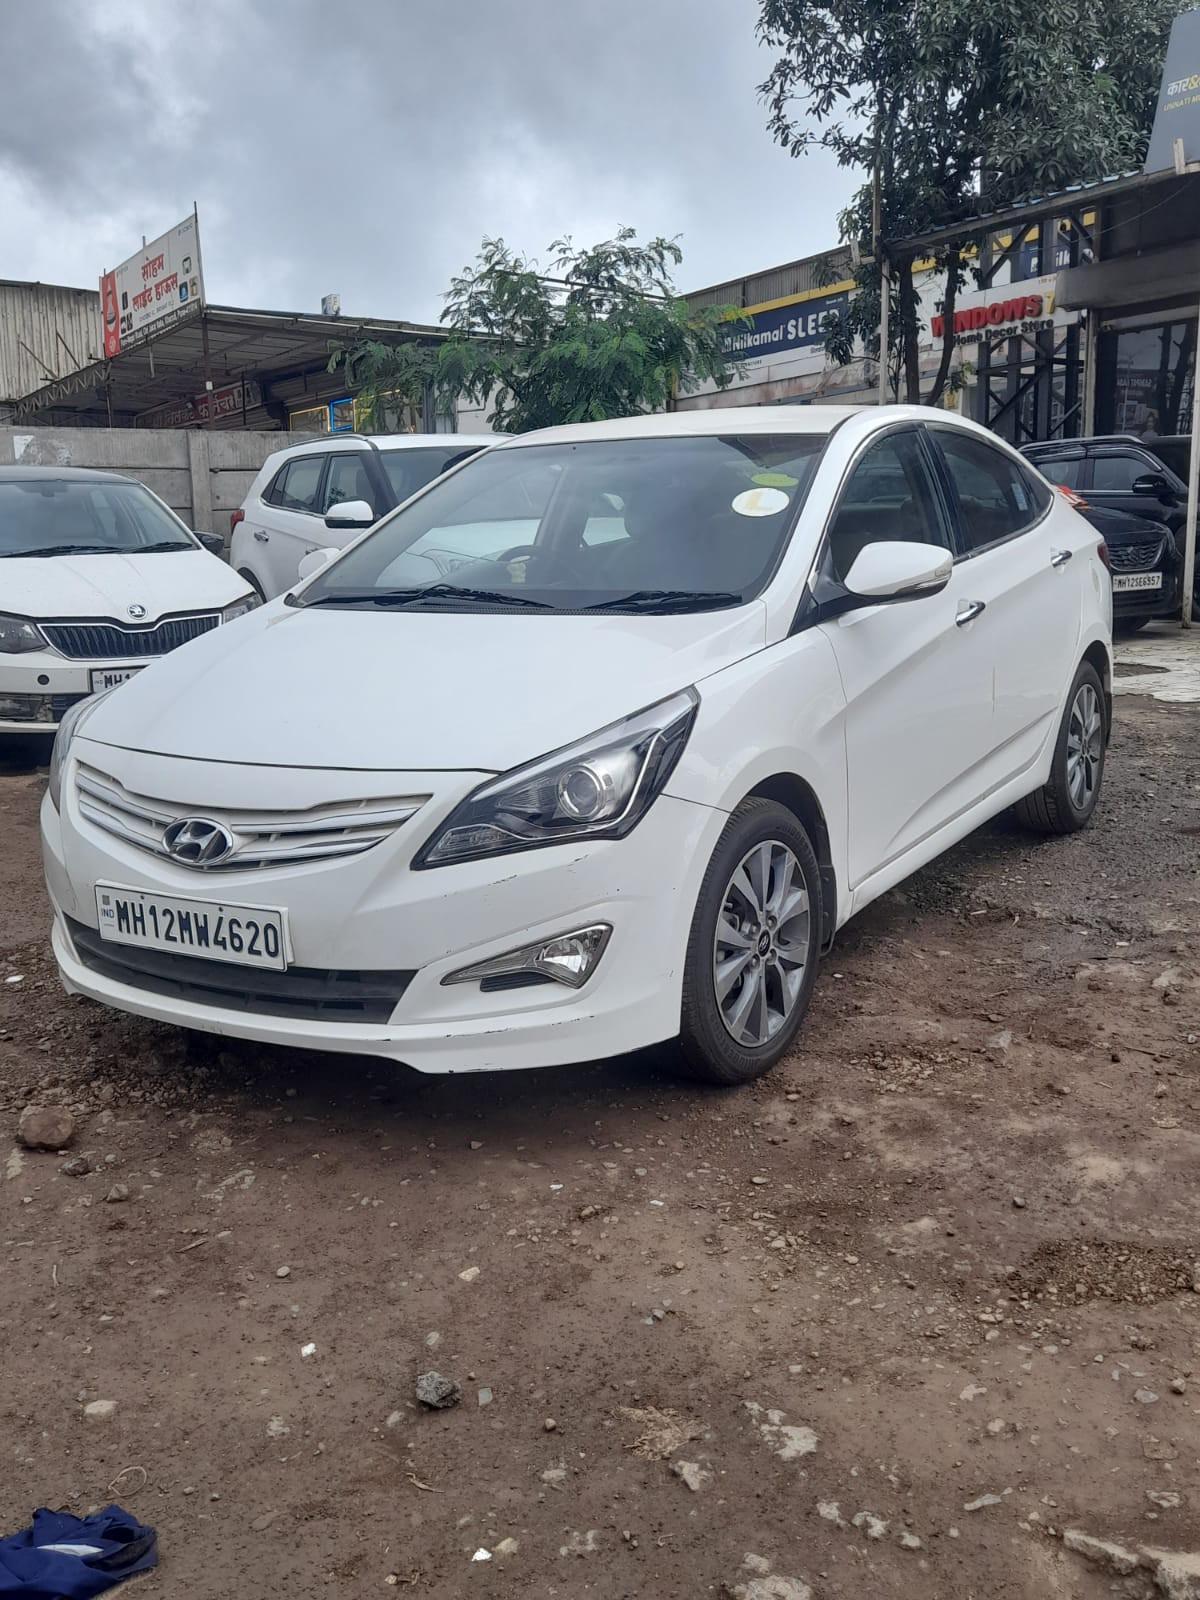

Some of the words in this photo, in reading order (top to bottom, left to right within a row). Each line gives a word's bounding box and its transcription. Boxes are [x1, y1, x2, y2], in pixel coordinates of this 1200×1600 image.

[931, 295, 1043, 337] WNDOWS
[1046, 289, 1056, 314] 7
[732, 325, 783, 351] Nilkamal
[953, 333, 983, 345] Home
[985, 325, 1018, 340] Decor
[1021, 319, 1054, 334] Store
[101, 906, 114, 919] IND
[115, 899, 279, 958] MH12MW4620
